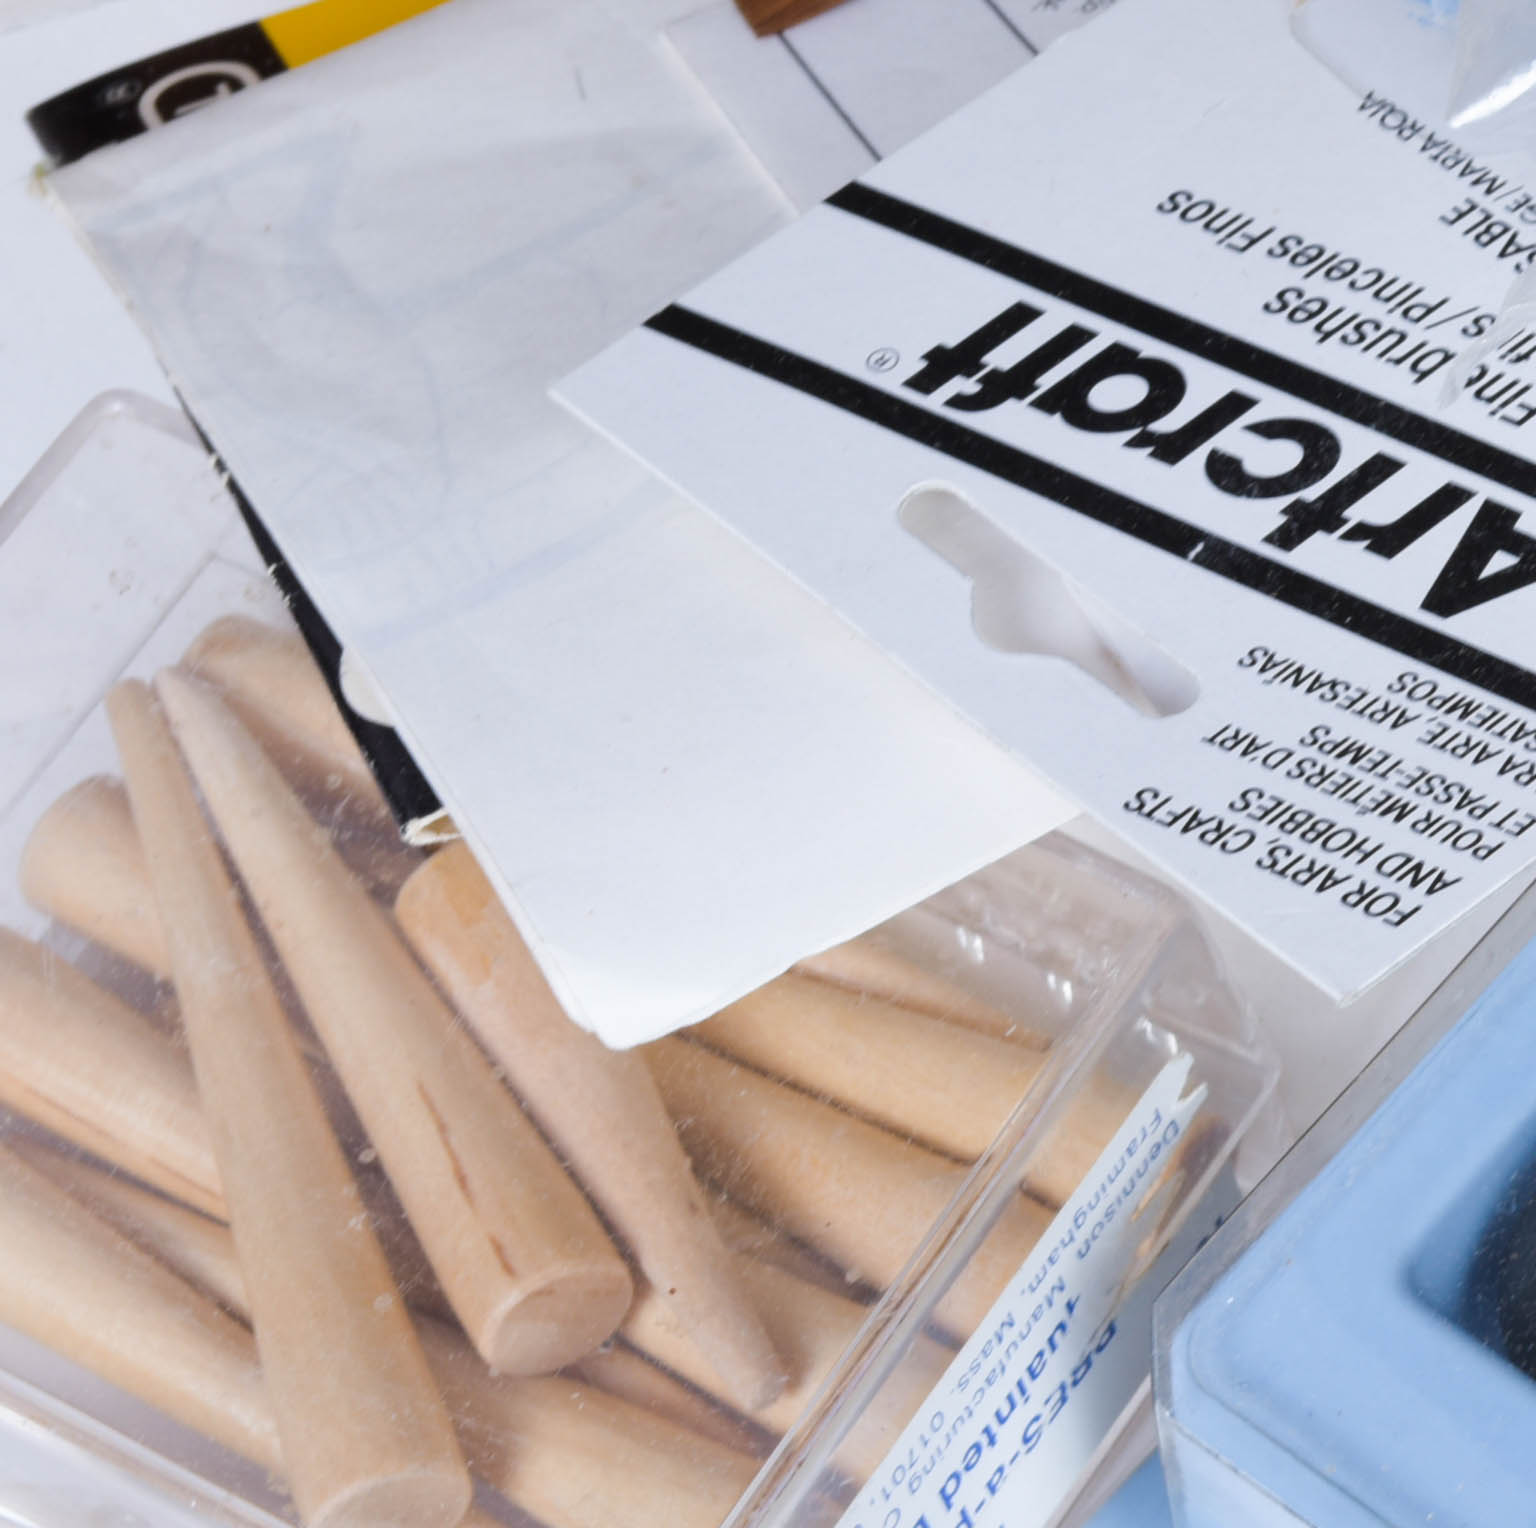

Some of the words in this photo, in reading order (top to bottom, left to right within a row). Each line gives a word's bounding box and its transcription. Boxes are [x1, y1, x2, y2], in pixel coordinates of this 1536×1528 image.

[1156, 189, 1276, 255] Finos
[1262, 285, 1458, 387] brushes
[1237, 645, 1422, 732] ARTESANÍAS
[1200, 722, 1296, 771] D'ART
[1298, 723, 1498, 824] PASSE-TEMPS
[1416, 714, 1505, 767] ARTE,
[1122, 785, 1258, 856] CRAFTS
[1284, 759, 1419, 825] MÉTIERS
[1227, 785, 1384, 868] HOBBIES
[1414, 815, 1506, 862] POUR
[1254, 836, 1354, 896] ARTS,
[1375, 850, 1464, 899] AND
[1340, 878, 1424, 930] FOR
[1076, 1118, 1181, 1261] Dennison
[906, 1274, 1068, 1497] Manufacturing
[950, 1310, 1018, 1395] Mass.
